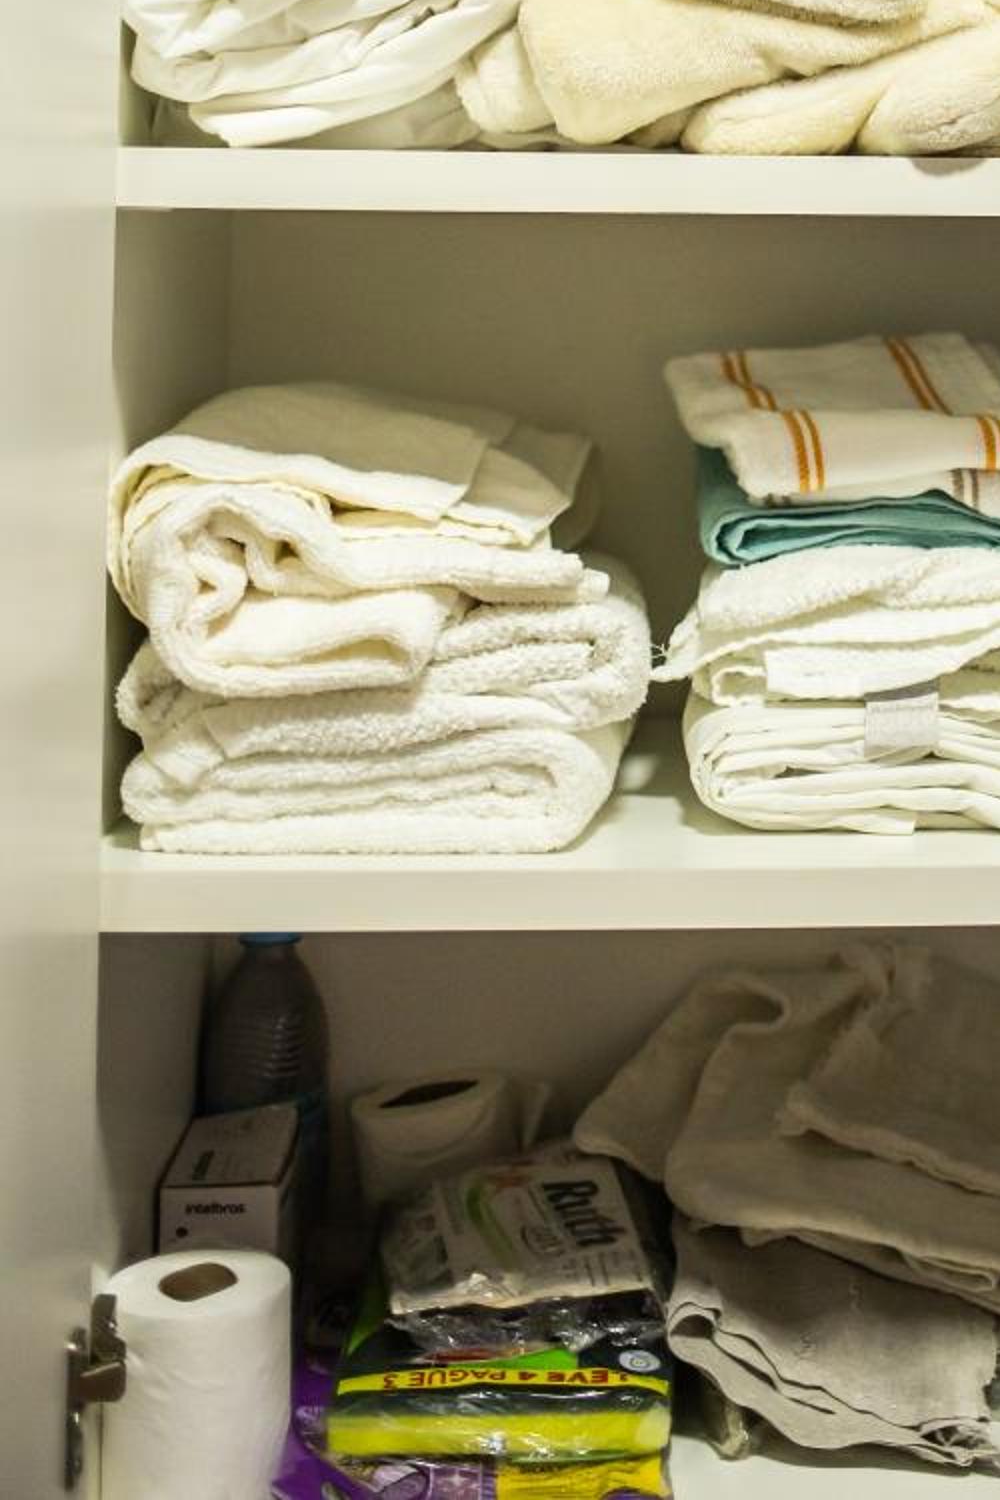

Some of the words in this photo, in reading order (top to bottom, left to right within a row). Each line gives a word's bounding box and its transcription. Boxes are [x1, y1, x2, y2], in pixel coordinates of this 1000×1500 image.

[383, 1371, 398, 1391] 3
[410, 1370, 506, 1386] PAGUE
[518, 1370, 536, 1381] 4
